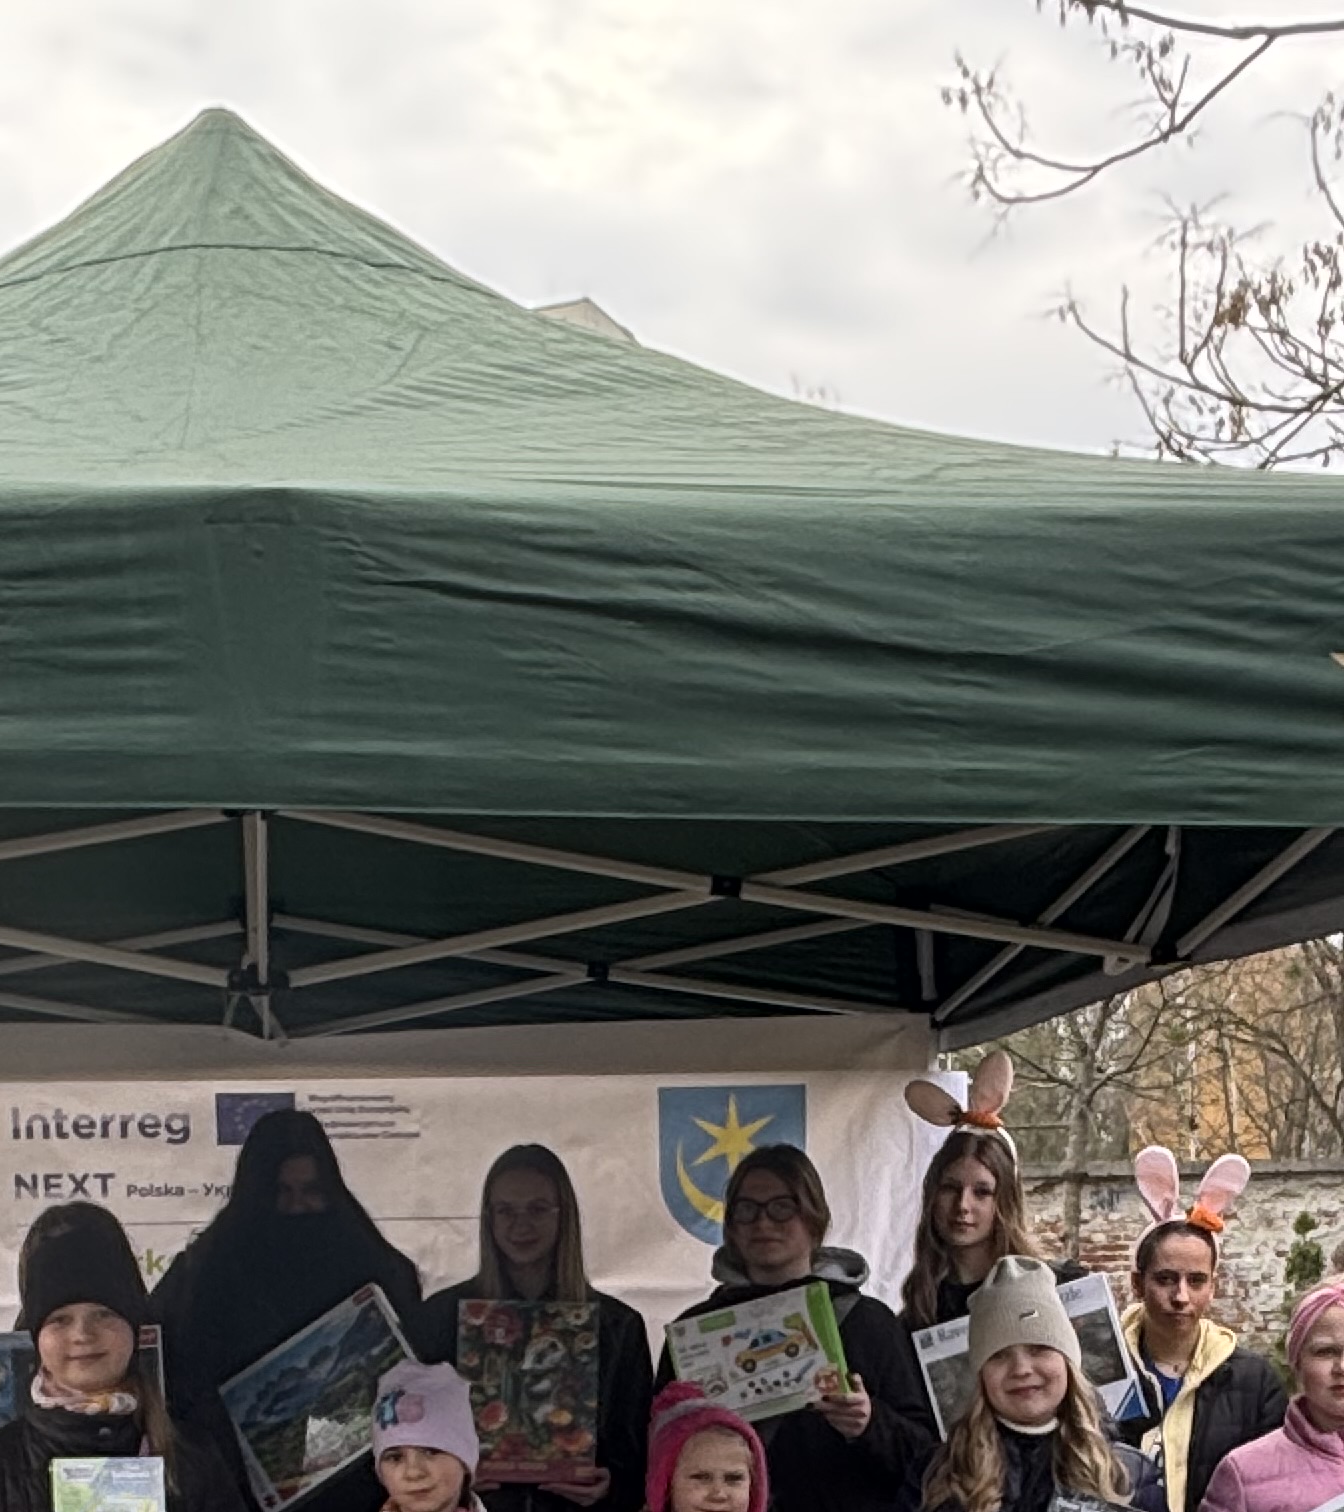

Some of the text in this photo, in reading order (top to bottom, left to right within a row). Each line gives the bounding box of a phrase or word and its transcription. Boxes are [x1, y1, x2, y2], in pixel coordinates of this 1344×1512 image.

[11, 1106, 191, 1144] Interreg
[14, 1173, 116, 1199] NEXT
[126, 1183, 185, 1198] Polska
